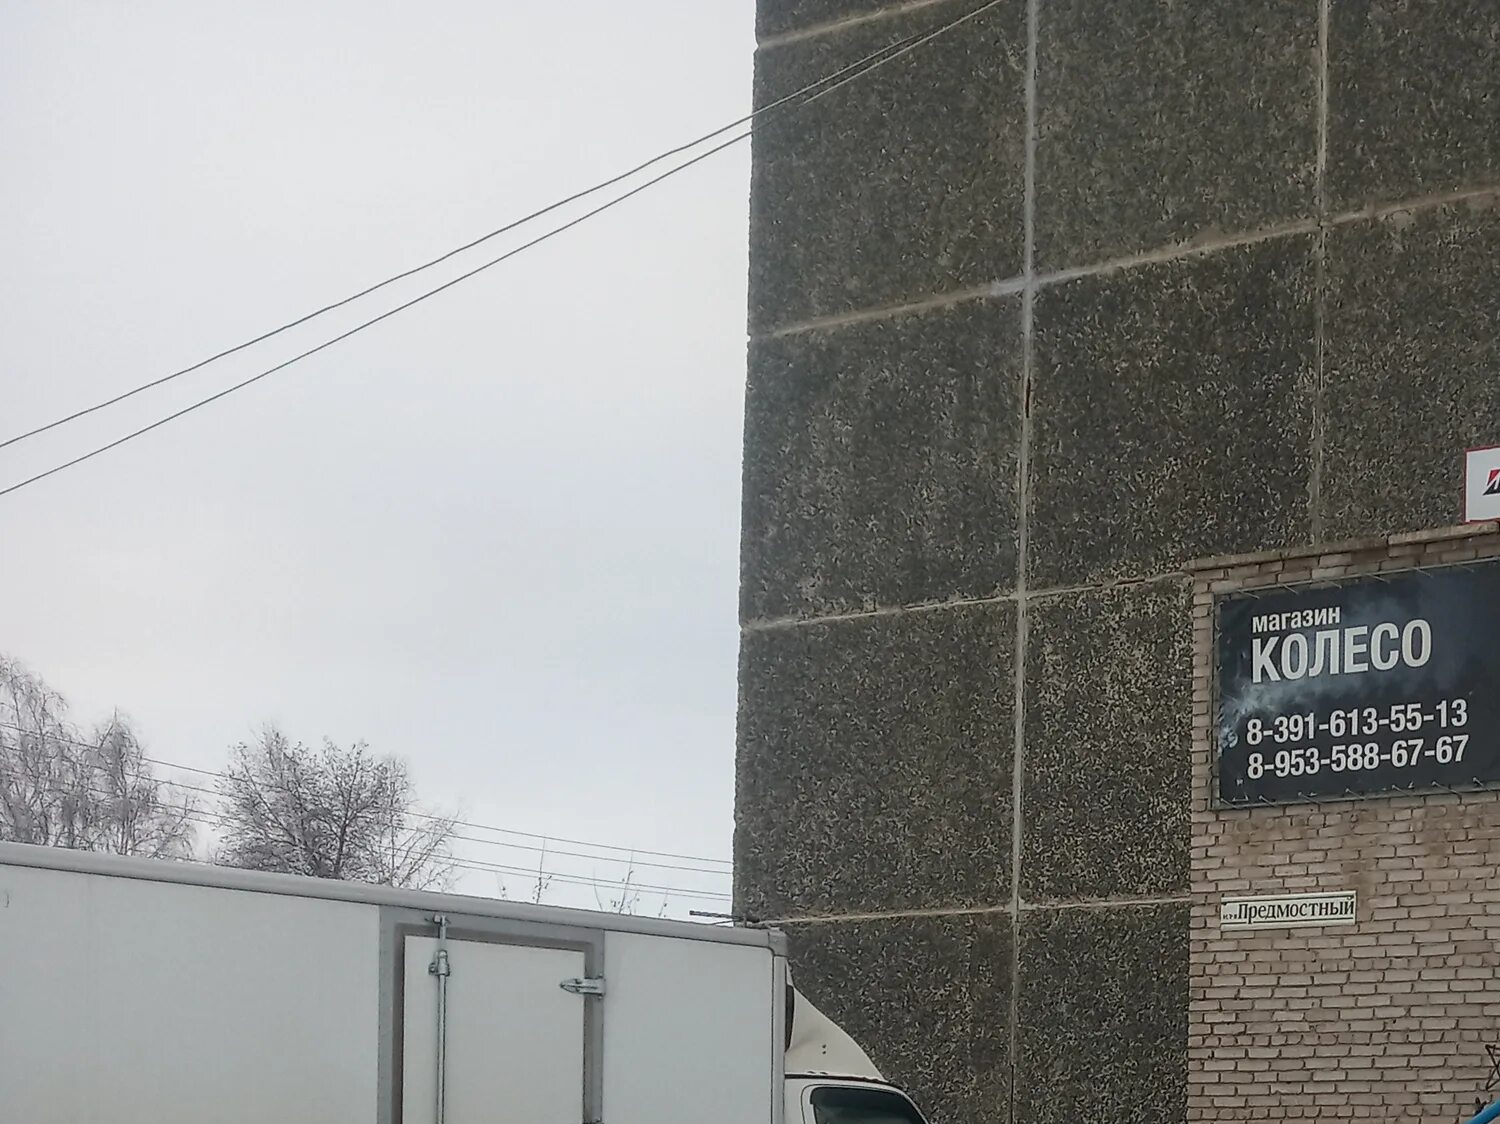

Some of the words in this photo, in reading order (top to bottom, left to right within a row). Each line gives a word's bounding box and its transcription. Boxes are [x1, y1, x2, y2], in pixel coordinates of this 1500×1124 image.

[1252, 606, 1341, 633] магазин
[1252, 619, 1432, 684] КОЛЕСО
[1246, 699, 1468, 745] 8-391-613-55-13
[1247, 734, 1469, 779] 8-953-588-67-67
[1238, 896, 1354, 924] Предмостный
